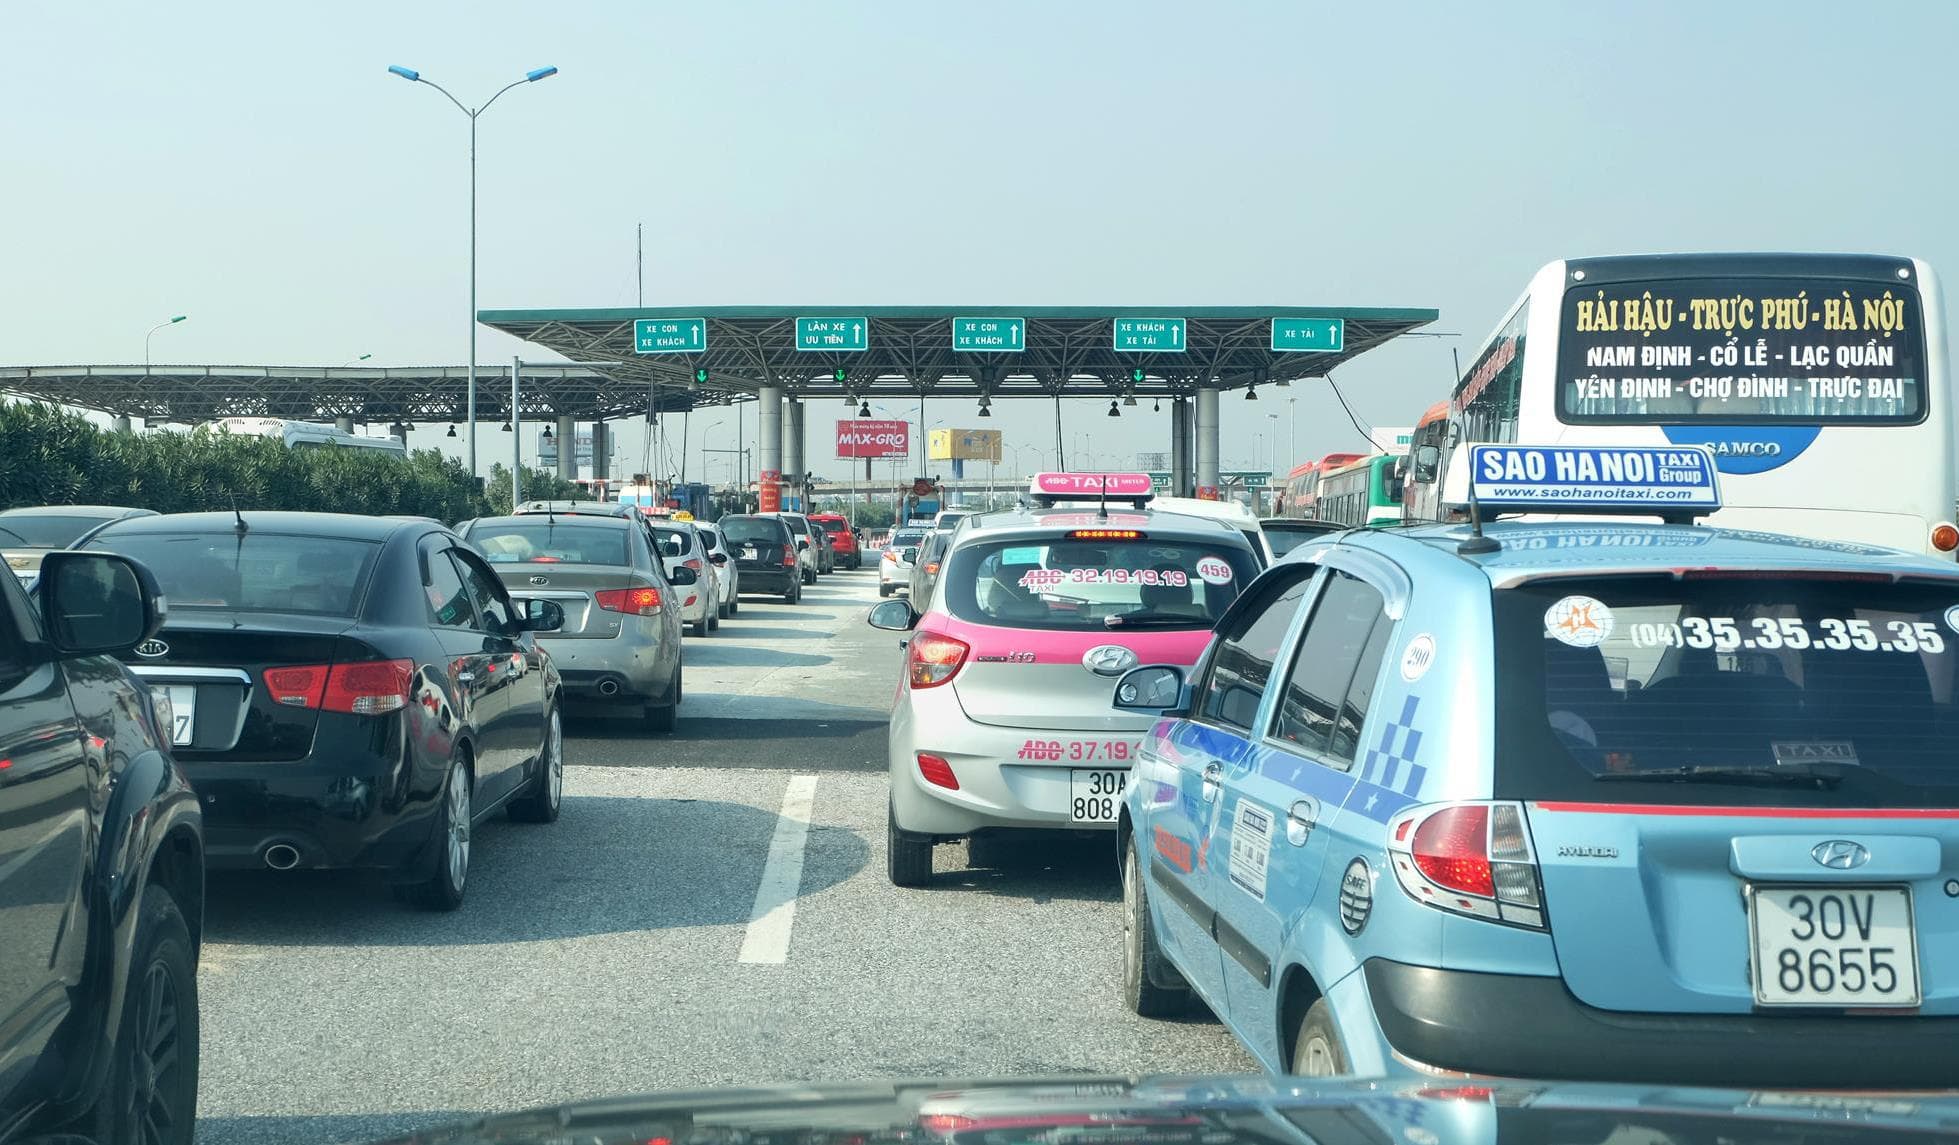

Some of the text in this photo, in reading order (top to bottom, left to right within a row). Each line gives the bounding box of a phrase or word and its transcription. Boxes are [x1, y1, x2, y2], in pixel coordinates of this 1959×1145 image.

[1576, 290, 1618, 331] HẢI
[1624, 291, 1673, 337] HẬU
[1690, 294, 1754, 337] TRỰC
[1760, 290, 1808, 331] PHÚ
[1823, 290, 1858, 331] HÀ
[1863, 290, 1905, 338] NỘI
[646, 324, 678, 333] XE CON
[807, 320, 846, 332] LÀN XE
[965, 323, 998, 332] XE CON
[1120, 322, 1132, 332] XE
[959, 336, 971, 345] XE
[1126, 336, 1138, 345] XE
[1284, 329, 1297, 338] XE
[641, 338, 653, 347] XE
[1587, 345, 1636, 367] NAM
[1640, 345, 1692, 371] ĐỊNH
[1709, 337, 1739, 367] CỔ
[1744, 338, 1768, 367] LỄ
[1790, 346, 1830, 370] LẠC
[1836, 338, 1894, 369] QUẦN
[1574, 374, 1619, 399] YÊN
[1621, 377, 1672, 403] ĐỊNH
[1689, 377, 1732, 402] CHỢ
[1737, 374, 1788, 399] ĐÌNH
[1808, 375, 1862, 403] TRỰC
[1868, 377, 1903, 402] ĐẠI
[838, 433, 905, 448] MAX-GRO
[1704, 441, 1781, 457] SAMCO
[1482, 450, 1546, 481] SAO
[1656, 453, 1700, 466] TAXI
[1070, 477, 1119, 488] TAXI
[1659, 468, 1702, 483] Group
[1494, 486, 1692, 499] www.saohanoitaxi.com
[1071, 569, 1188, 587] 32.19.19.19
[1200, 563, 1231, 579] 459
[1089, 771, 1126, 795] 30A
[1557, 846, 1619, 858] HYUNDAI
[1788, 894, 1875, 941] 30V
[1778, 948, 1897, 994] 8655
